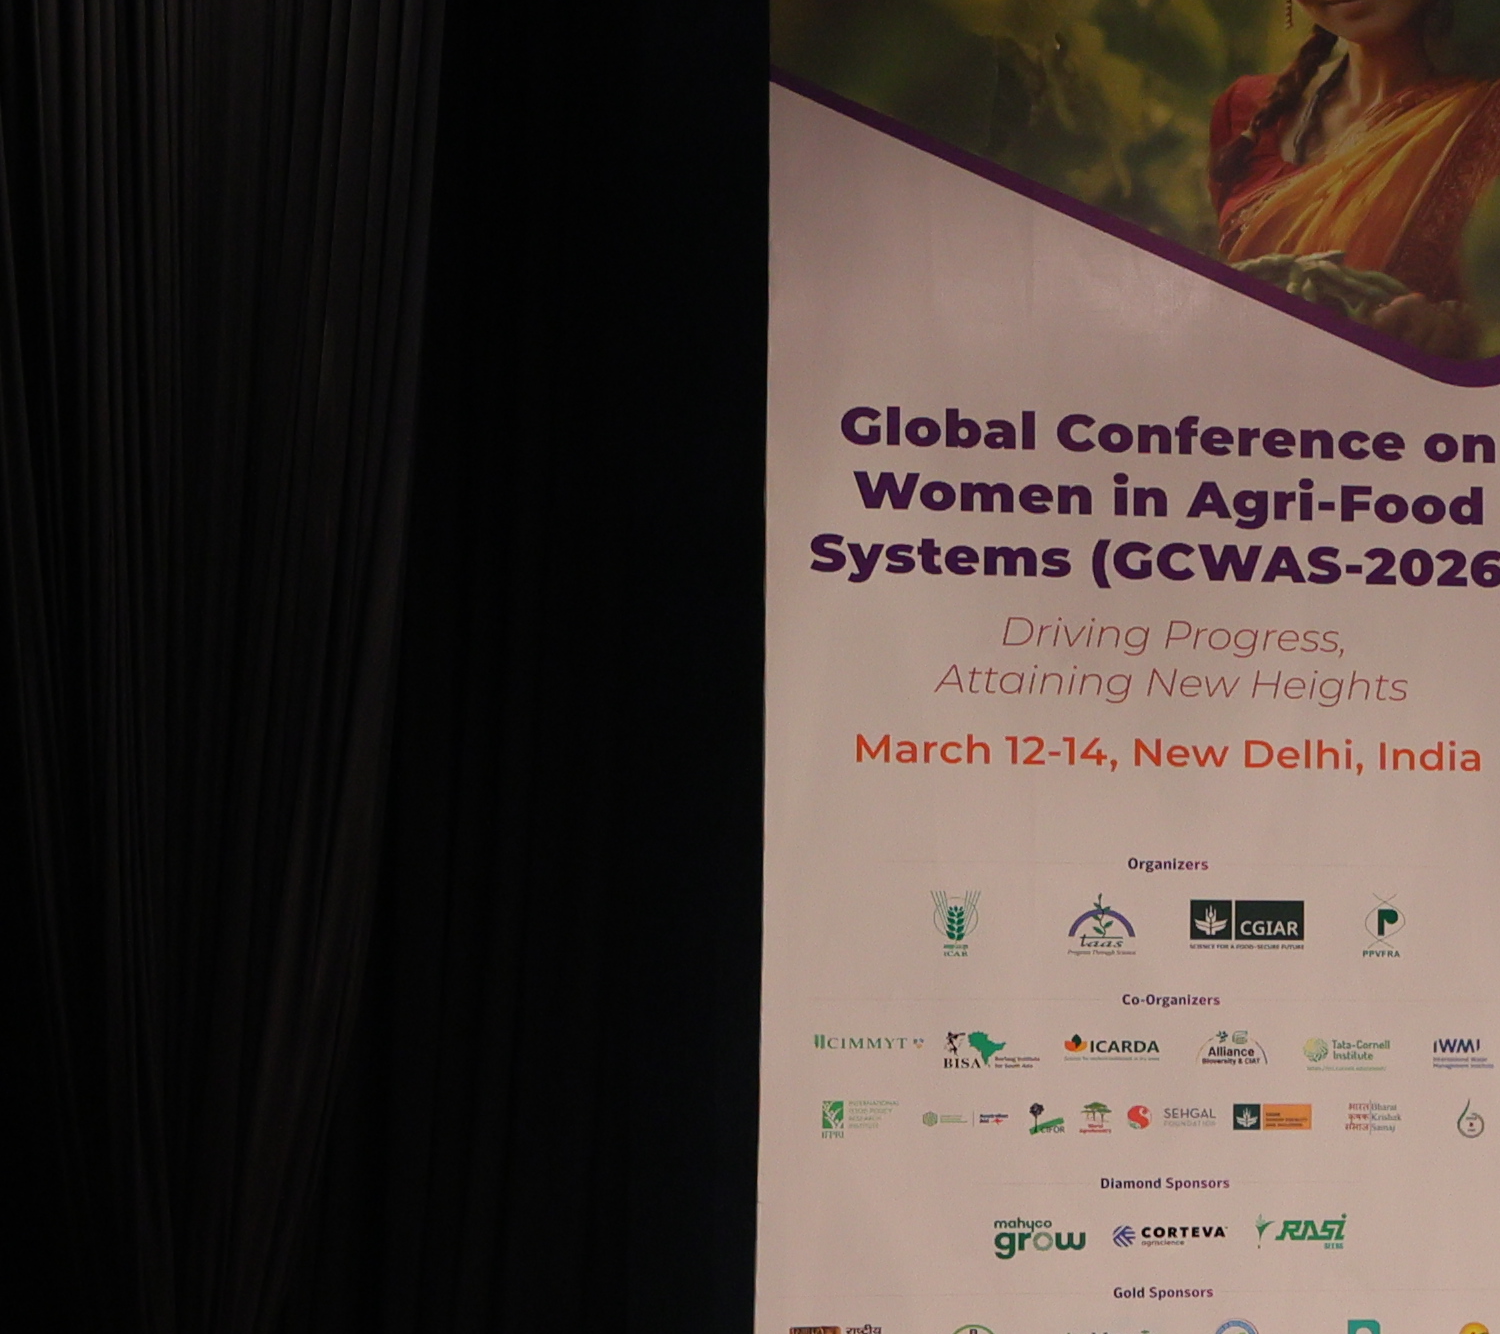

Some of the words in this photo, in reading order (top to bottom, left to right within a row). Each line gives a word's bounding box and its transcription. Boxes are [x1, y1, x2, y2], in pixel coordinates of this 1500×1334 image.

[840, 405, 1036, 451] Global
[1056, 413, 1406, 462] Conference
[1423, 432, 1496, 464] on
[852, 470, 1093, 516] Women
[1113, 472, 1168, 518] in
[1185, 477, 1484, 530] Agri-Food
[809, 533, 1072, 584] Systems
[1002, 616, 1150, 657] Driving
[1164, 619, 1345, 659] Progress,
[933, 663, 1133, 704] Attaining
[1146, 667, 1241, 698] New
[1251, 669, 1409, 708] Heights
[855, 733, 991, 765] March
[1004, 735, 1118, 773] 12-14,
[1134, 737, 1230, 768] New
[1244, 738, 1364, 777] Delhi,
[1379, 740, 1481, 772] India
[1127, 857, 1209, 873] Organizers
[1240, 920, 1298, 937] CGIAR
[1080, 933, 1124, 948] taas
[1362, 949, 1401, 958] PPVFRA
[1121, 993, 1221, 1009] Co-Organizers
[828, 1036, 908, 1050] CIMMYT
[1090, 1040, 1160, 1053] ICARDA
[1332, 1039, 1391, 1051] Tata-Cornell
[1433, 1038, 1480, 1053] IWMI
[1208, 1046, 1255, 1057] Alliance
[1332, 1050, 1374, 1061] Institute
[943, 1057, 981, 1069] BISA
[1163, 1107, 1217, 1119] SEHGAL
[1100, 1177, 1162, 1190] Diamond
[1165, 1176, 1230, 1192] Sponsors
[994, 1217, 1052, 1231] mahyco
[1141, 1226, 1226, 1239] CORTEVA
[994, 1231, 1086, 1260] grow
[1113, 1286, 1145, 1299] Gold
[1149, 1286, 1214, 1301] Sponsors
